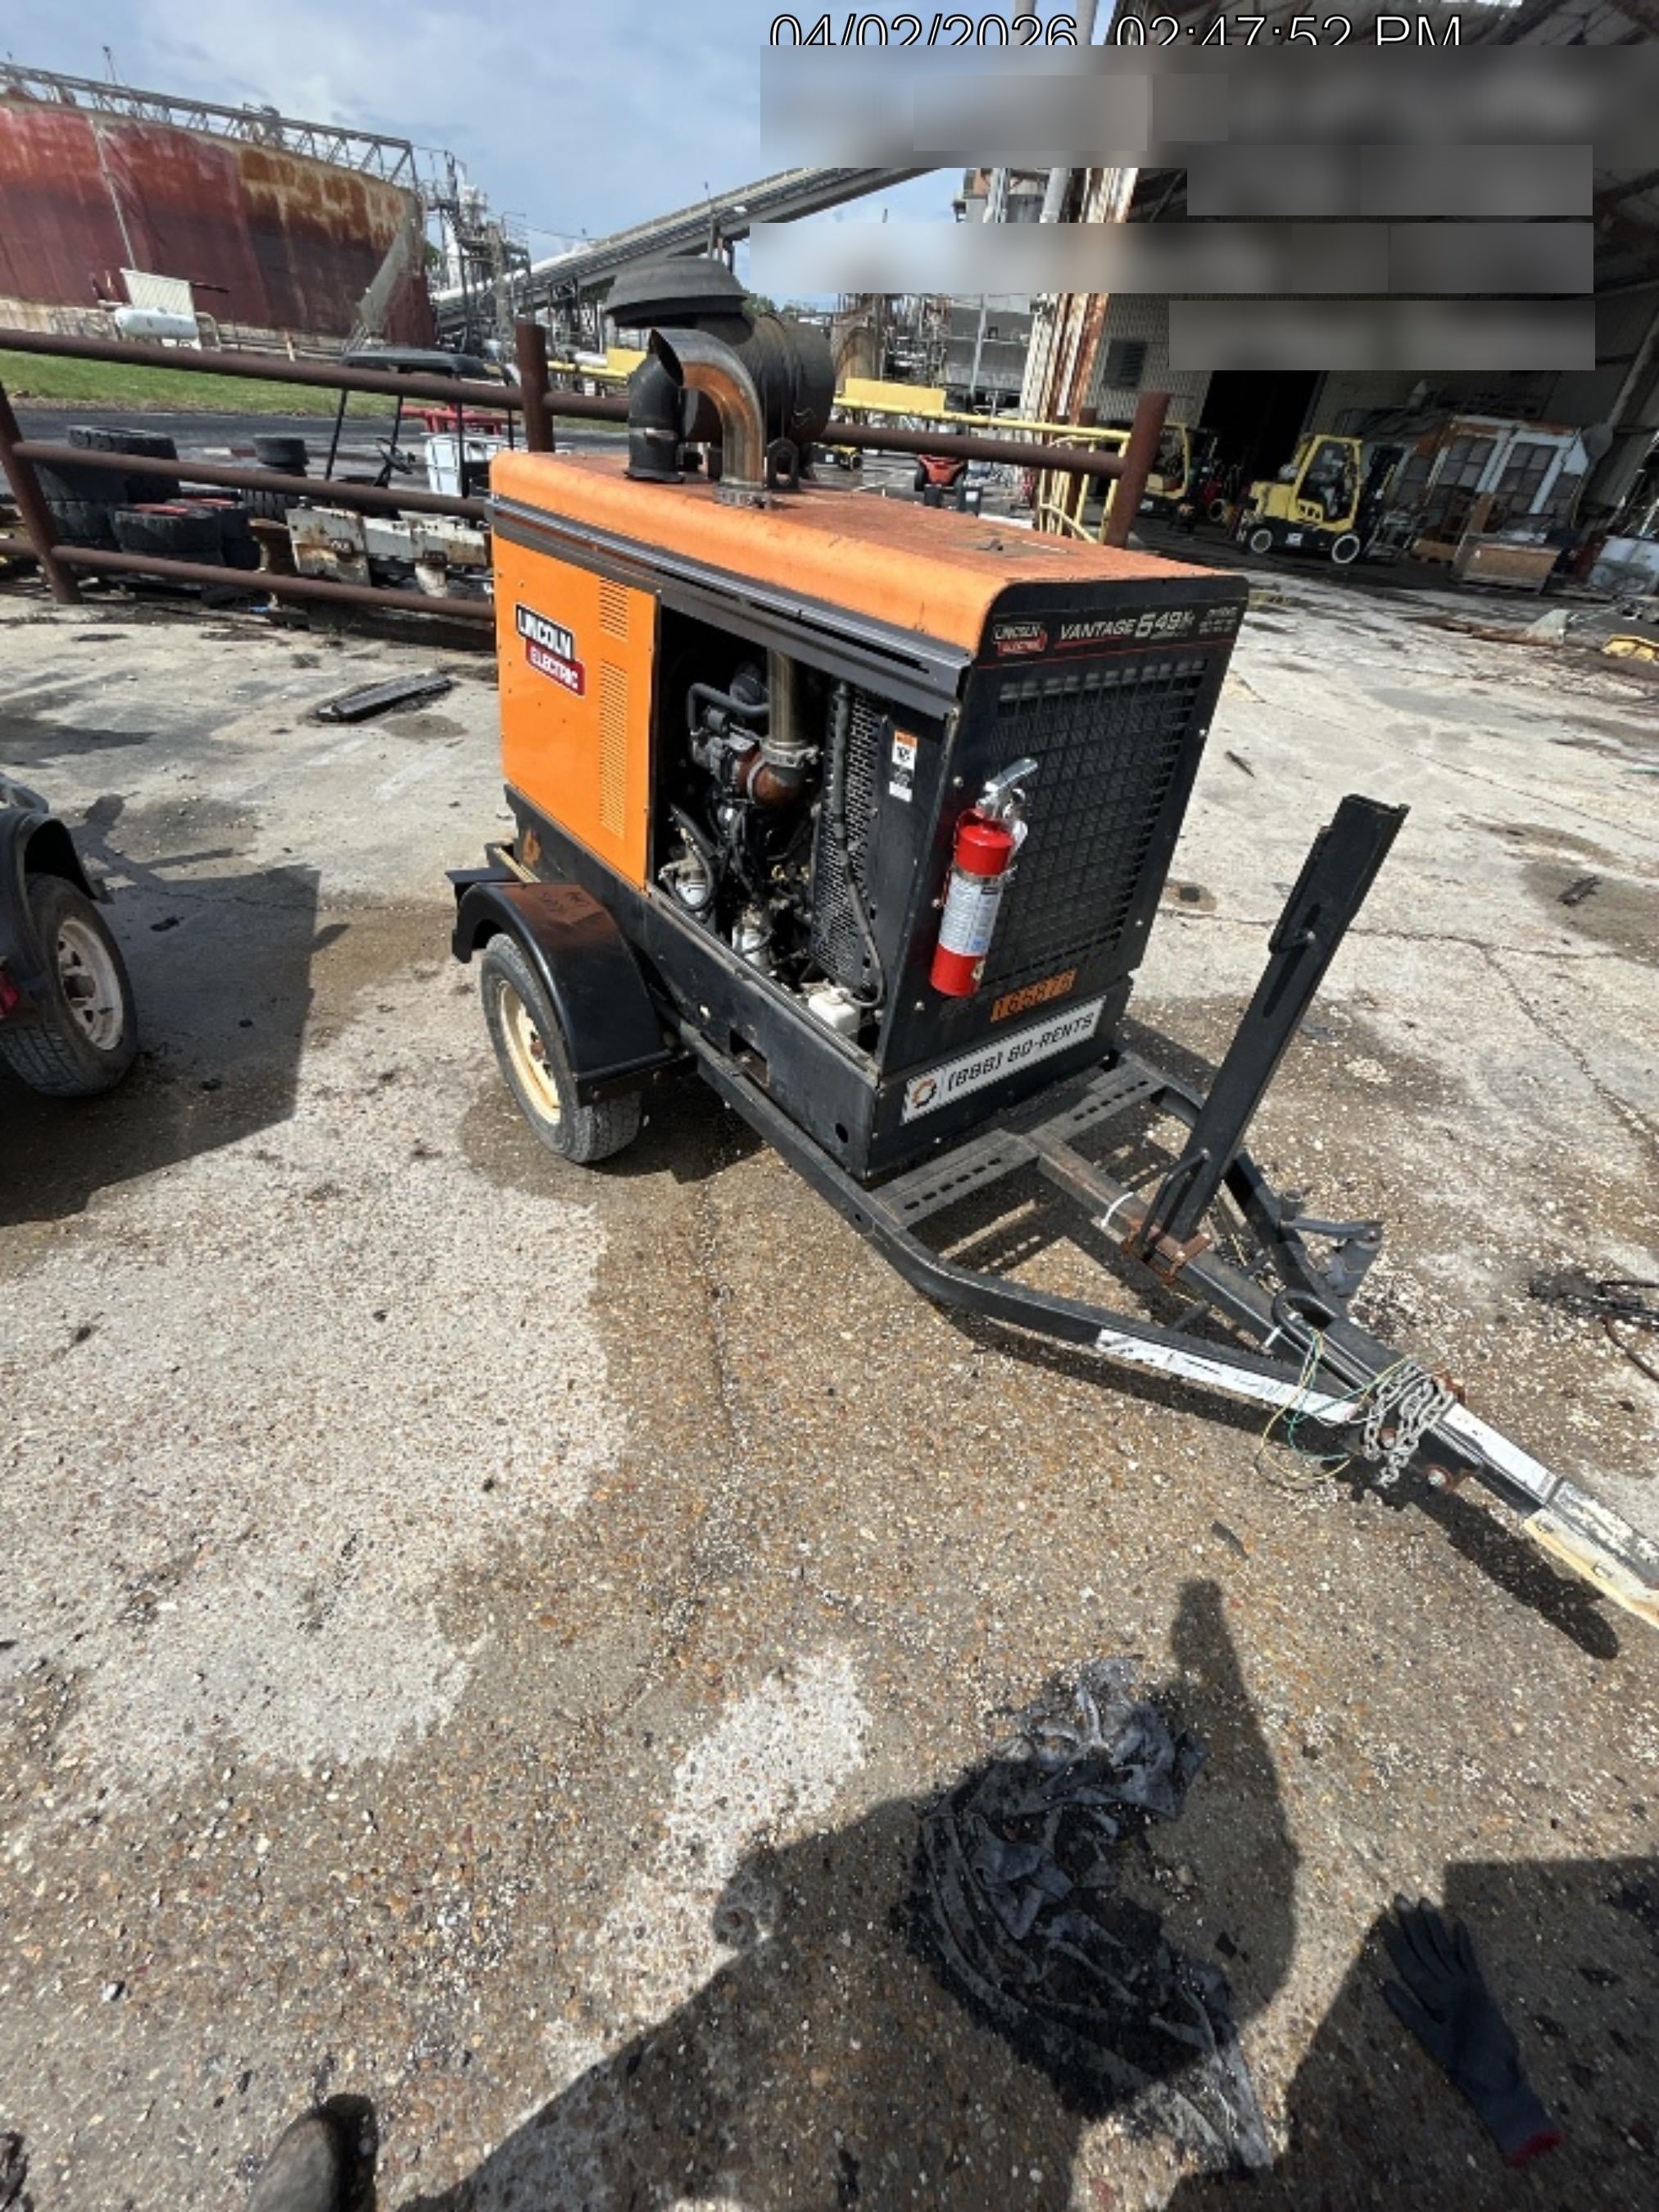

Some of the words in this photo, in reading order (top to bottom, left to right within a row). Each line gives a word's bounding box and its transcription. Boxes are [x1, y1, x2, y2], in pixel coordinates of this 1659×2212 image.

[518, 609, 571, 660] LINCOLN
[1061, 619, 1136, 640] VANTAGE
[530, 646, 578, 690] ELECTRIC
